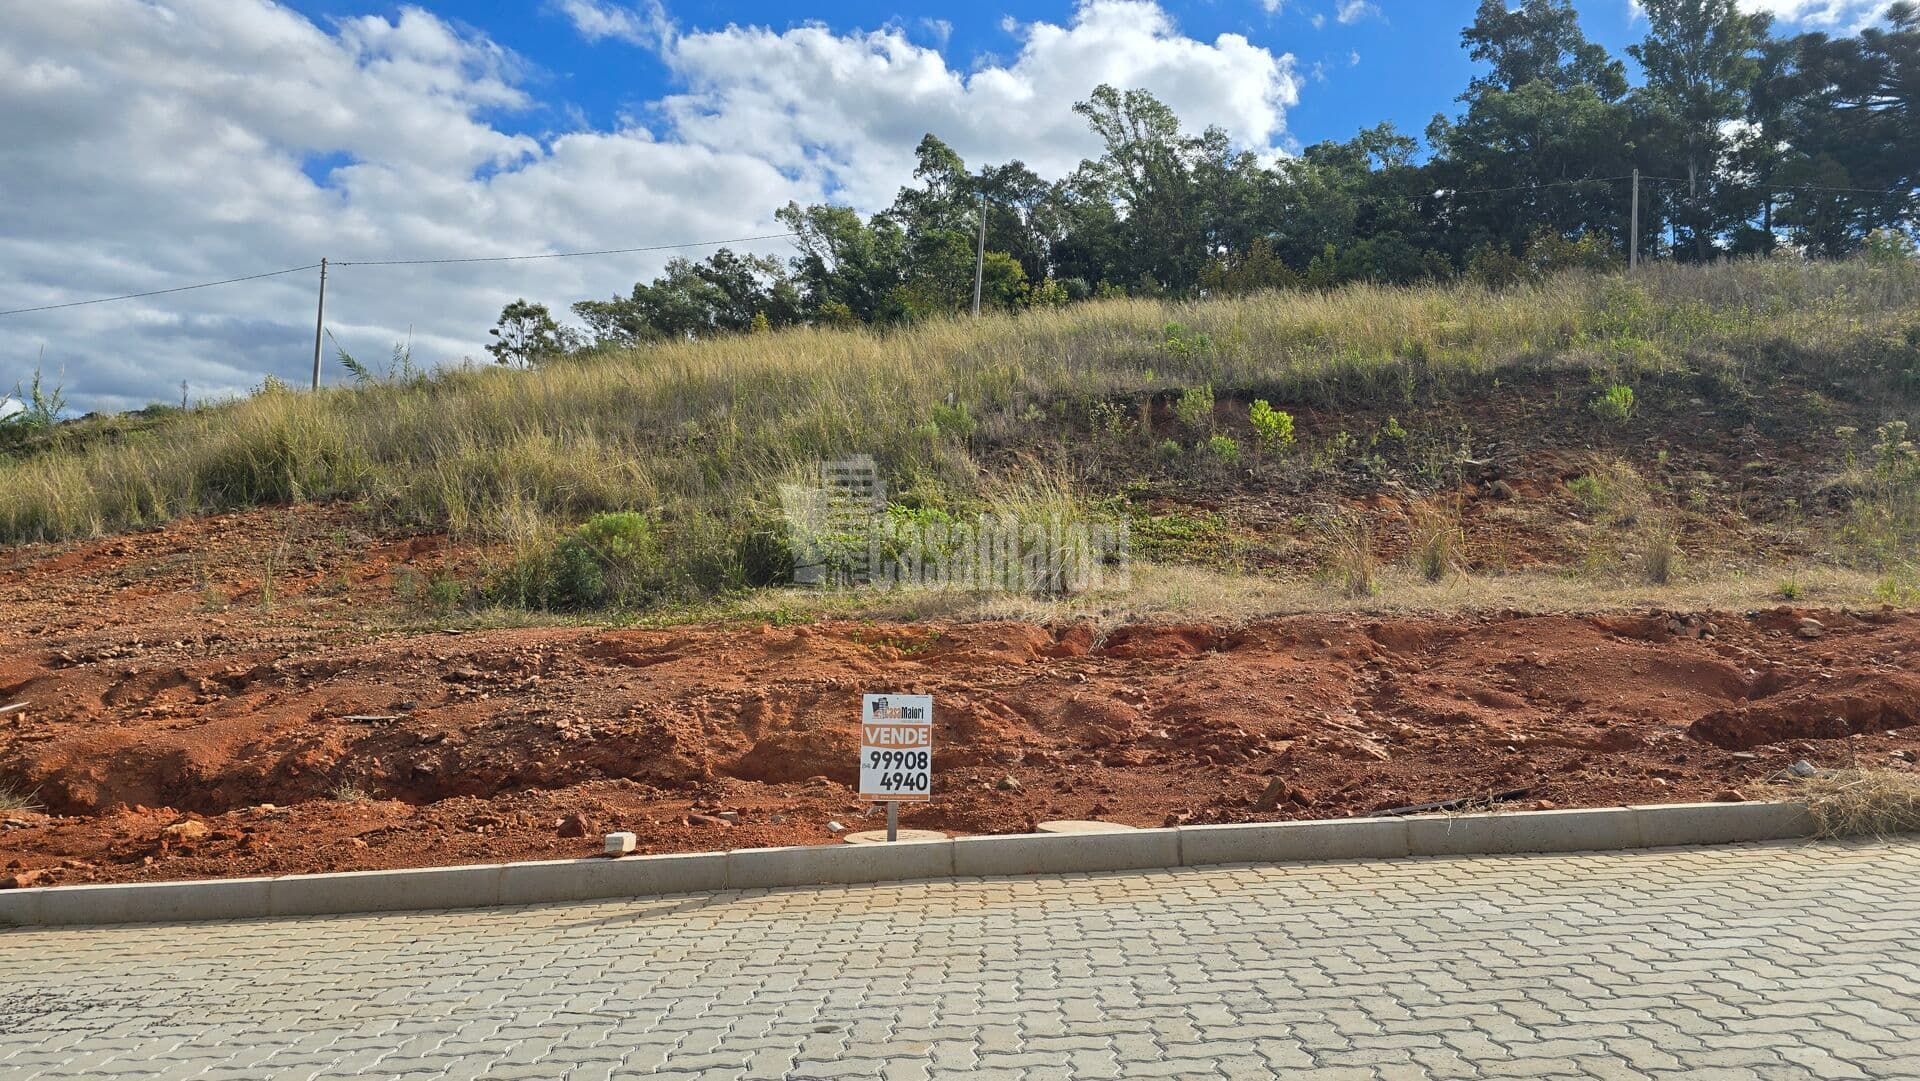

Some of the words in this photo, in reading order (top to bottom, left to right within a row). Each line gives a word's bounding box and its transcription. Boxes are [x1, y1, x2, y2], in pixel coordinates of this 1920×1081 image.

[864, 727, 928, 745] VENDE
[870, 751, 928, 770] 99908
[880, 772, 928, 791] 4940
